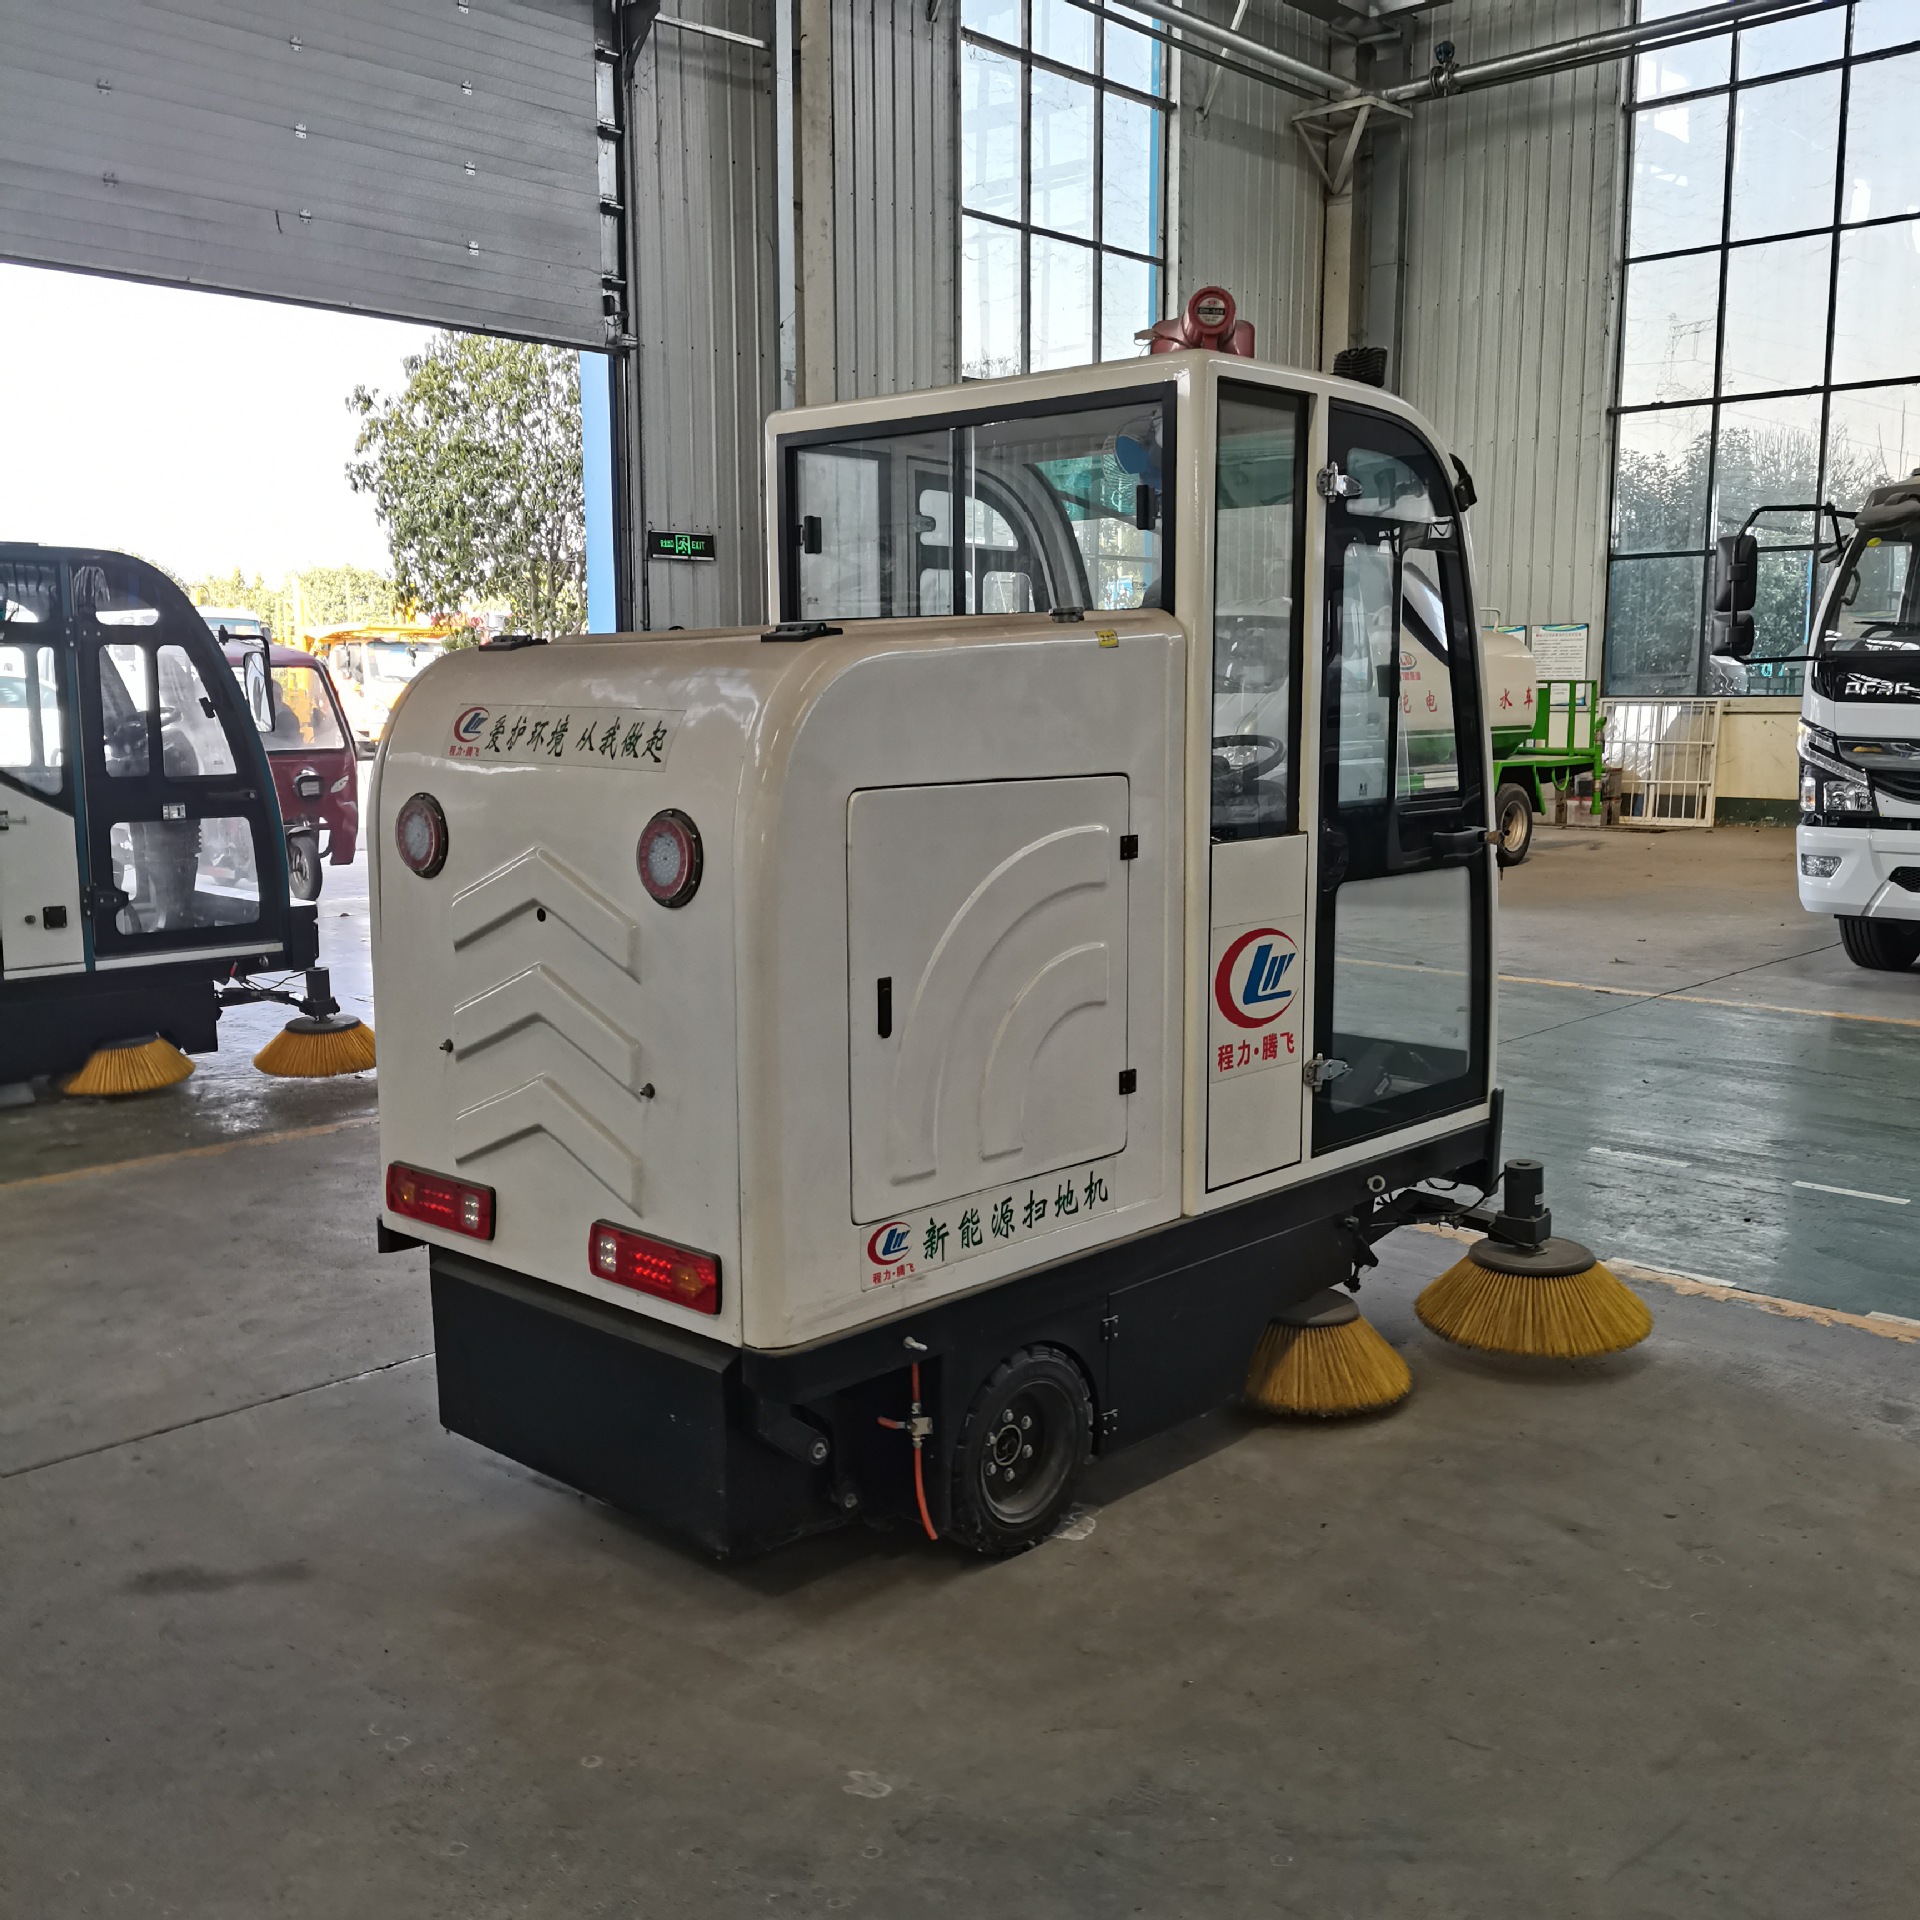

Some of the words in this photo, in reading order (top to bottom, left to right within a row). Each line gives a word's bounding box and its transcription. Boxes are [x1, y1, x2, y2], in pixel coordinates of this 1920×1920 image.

[691, 540, 705, 551] EXIT
[485, 714, 570, 757] 爱护环境
[575, 716, 668, 763] 从我做起
[922, 1170, 1109, 1262] 新能源扫地机
